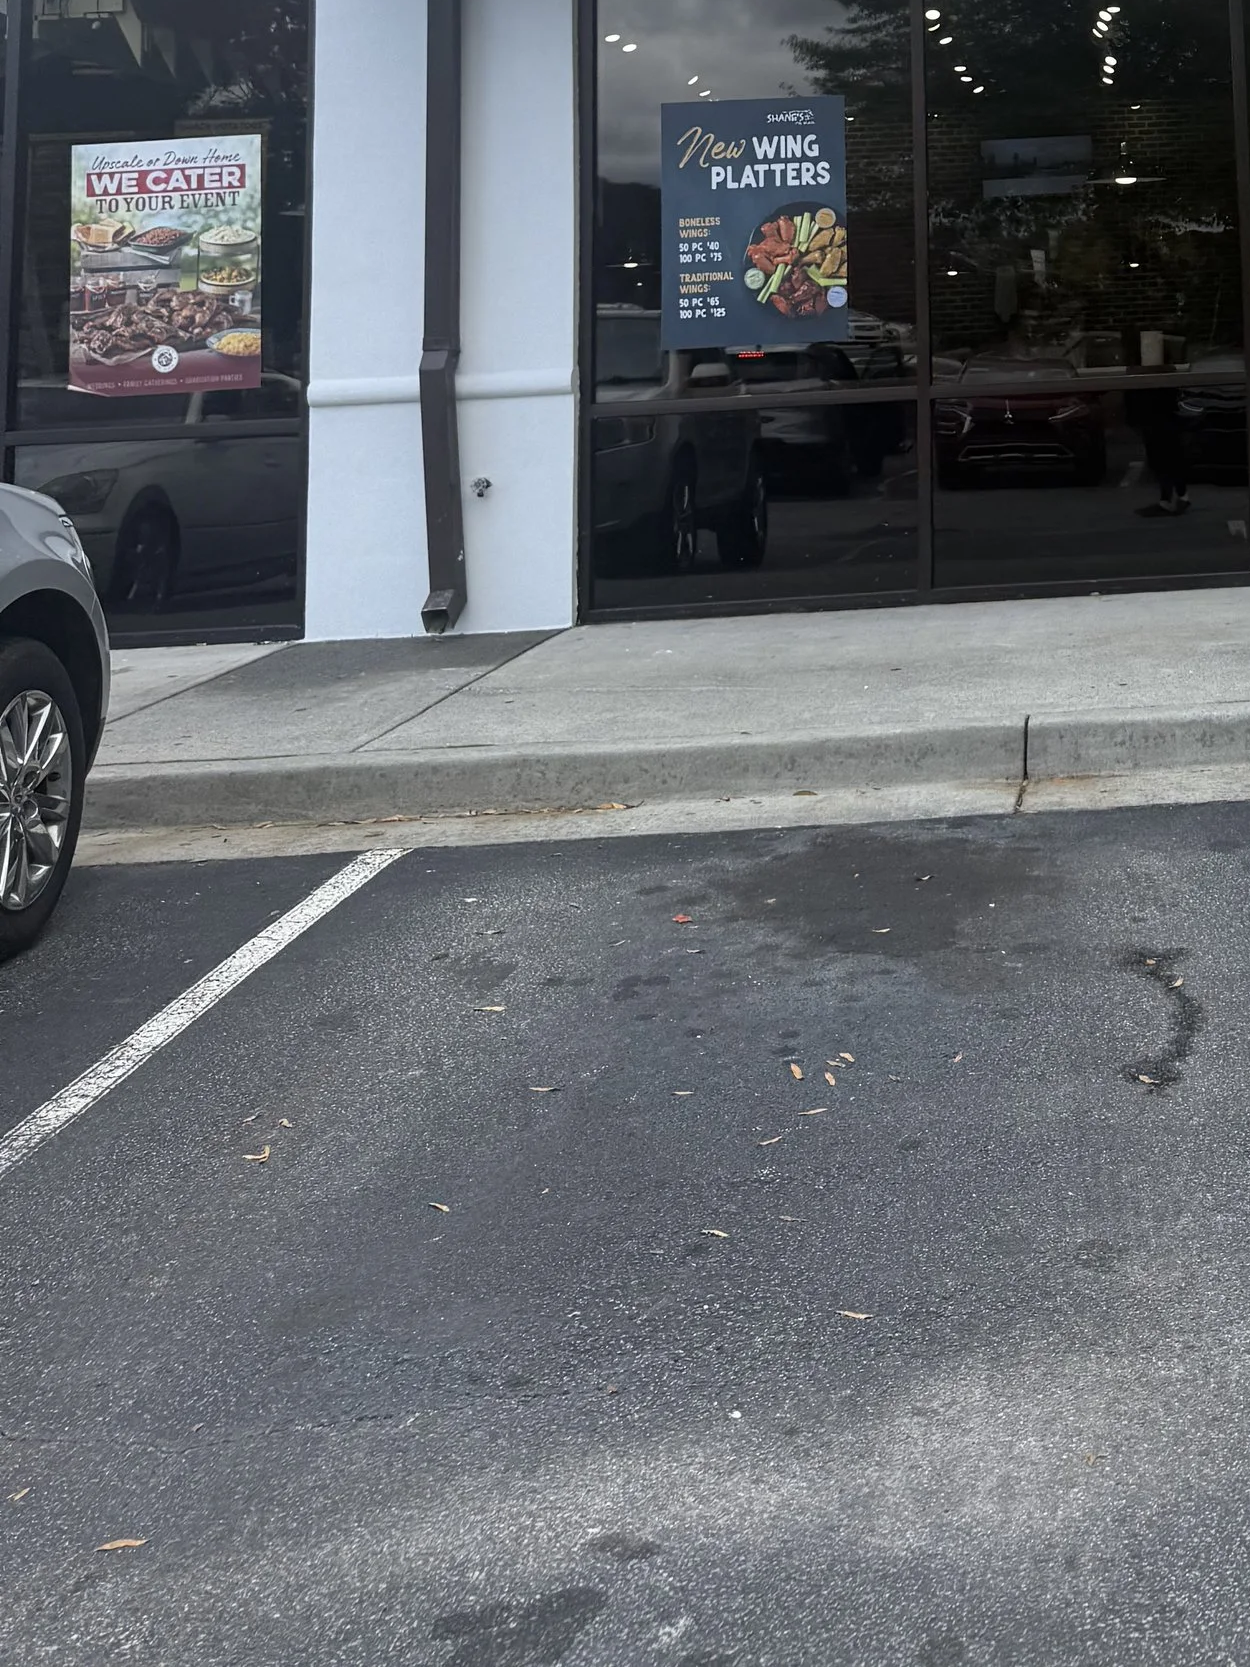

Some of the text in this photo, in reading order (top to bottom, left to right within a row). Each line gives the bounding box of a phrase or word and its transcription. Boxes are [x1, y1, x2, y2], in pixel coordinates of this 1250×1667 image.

[677, 126, 819, 168] New WING
[92, 148, 241, 172] Upscale or Down Home
[90, 166, 241, 195] WE CATER
[711, 161, 831, 190] PLATTERS
[96, 190, 240, 214] TO YOUR EVENT
[679, 217, 720, 227] BONELESS
[679, 228, 711, 238] WINGS:
[679, 243, 689, 252] 50
[692, 242, 703, 251] PC
[679, 254, 692, 263] 100
[695, 253, 706, 262] PC
[679, 271, 734, 282] TRADITIONAL
[679, 283, 711, 294] WINGS:
[679, 298, 689, 307] 50
[692, 297, 703, 307] PC
[679, 310, 692, 319] 100
[695, 308, 706, 318] PC
